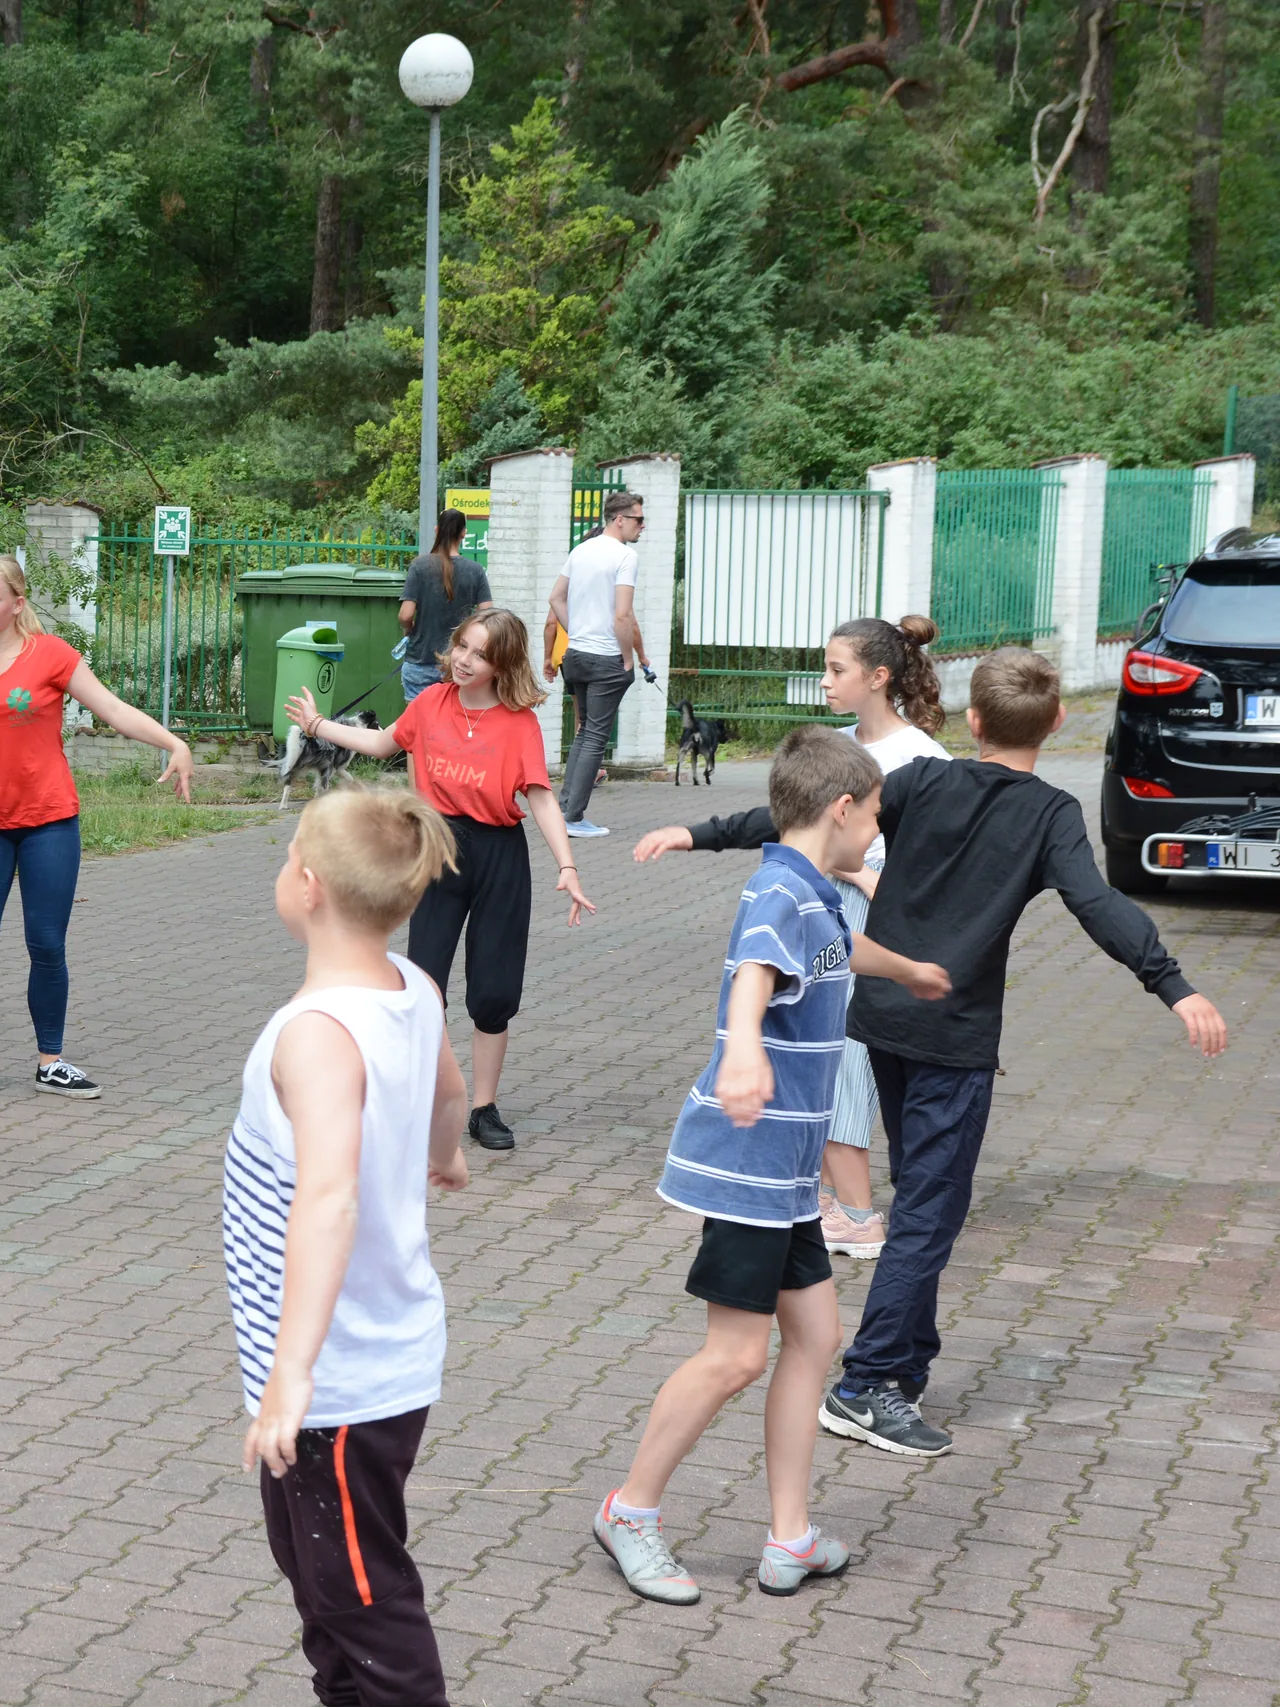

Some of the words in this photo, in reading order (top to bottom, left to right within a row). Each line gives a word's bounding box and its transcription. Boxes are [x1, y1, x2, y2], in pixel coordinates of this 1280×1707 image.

[451, 498, 490, 508] Ośrodek
[1168, 708, 1210, 717] HYUNDAI
[426, 755, 487, 788] DENIM
